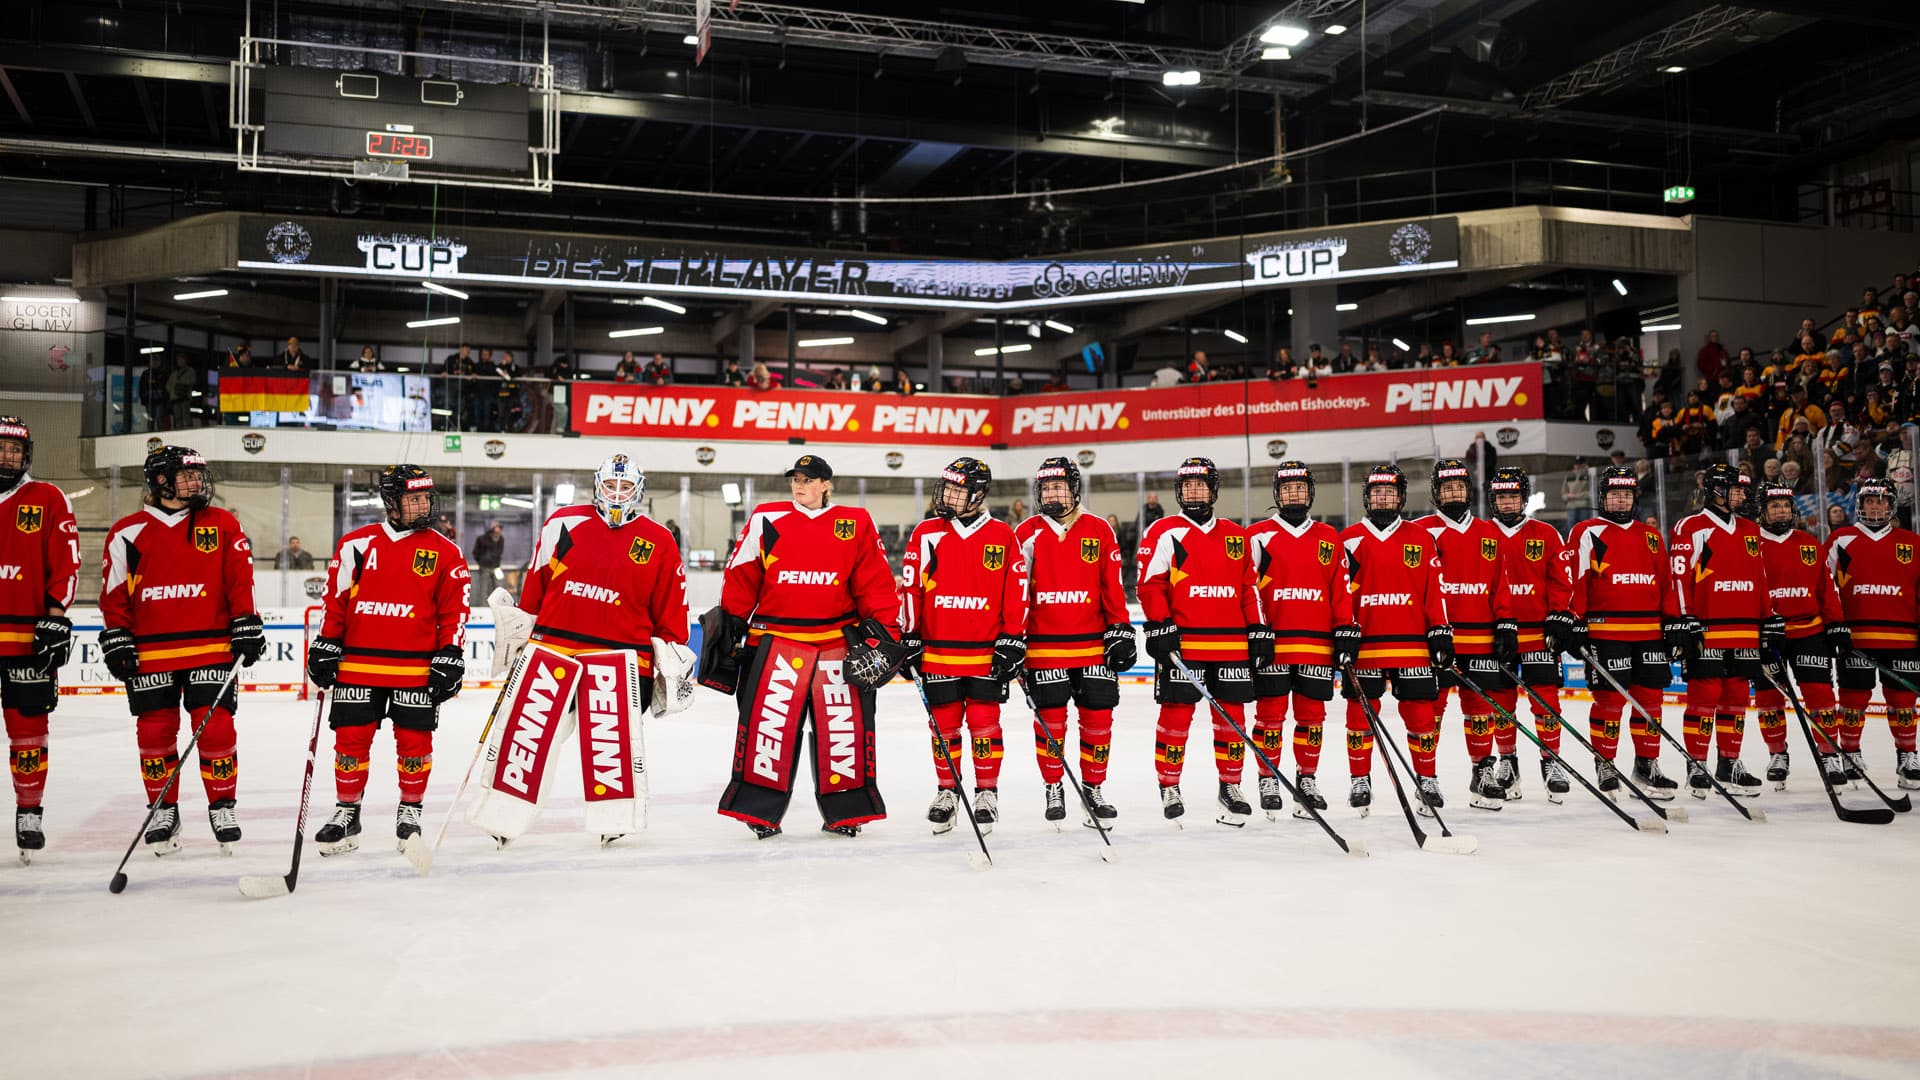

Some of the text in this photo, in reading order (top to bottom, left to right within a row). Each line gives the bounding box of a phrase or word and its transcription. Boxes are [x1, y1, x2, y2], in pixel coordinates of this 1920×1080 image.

[372, 243, 453, 273] CUP
[1260, 248, 1333, 279] CUP
[16, 303, 72, 318] LOGEN
[1142, 395, 1371, 421] Unterstützer des Deutschen Eishockeys.
[0, 425, 28, 438] ENNY.
[365, 548, 377, 570] A
[777, 570, 840, 586] PENNY.
[141, 583, 207, 602] PENNY.
[563, 580, 622, 606] PENNY.
[1036, 590, 1091, 604] PENNY.
[1360, 593, 1413, 607] PENNY.
[354, 600, 415, 618] PENNY.
[934, 595, 991, 610] PENNY.
[1608, 656, 1632, 669] CINQ
[1642, 651, 1668, 662] CINQ
[1892, 659, 1920, 671] CINQU
[132, 671, 174, 689] CINQUE
[502, 660, 566, 794] PENNY.
[753, 653, 804, 783] PENNY.
[587, 664, 623, 796] PENNY.
